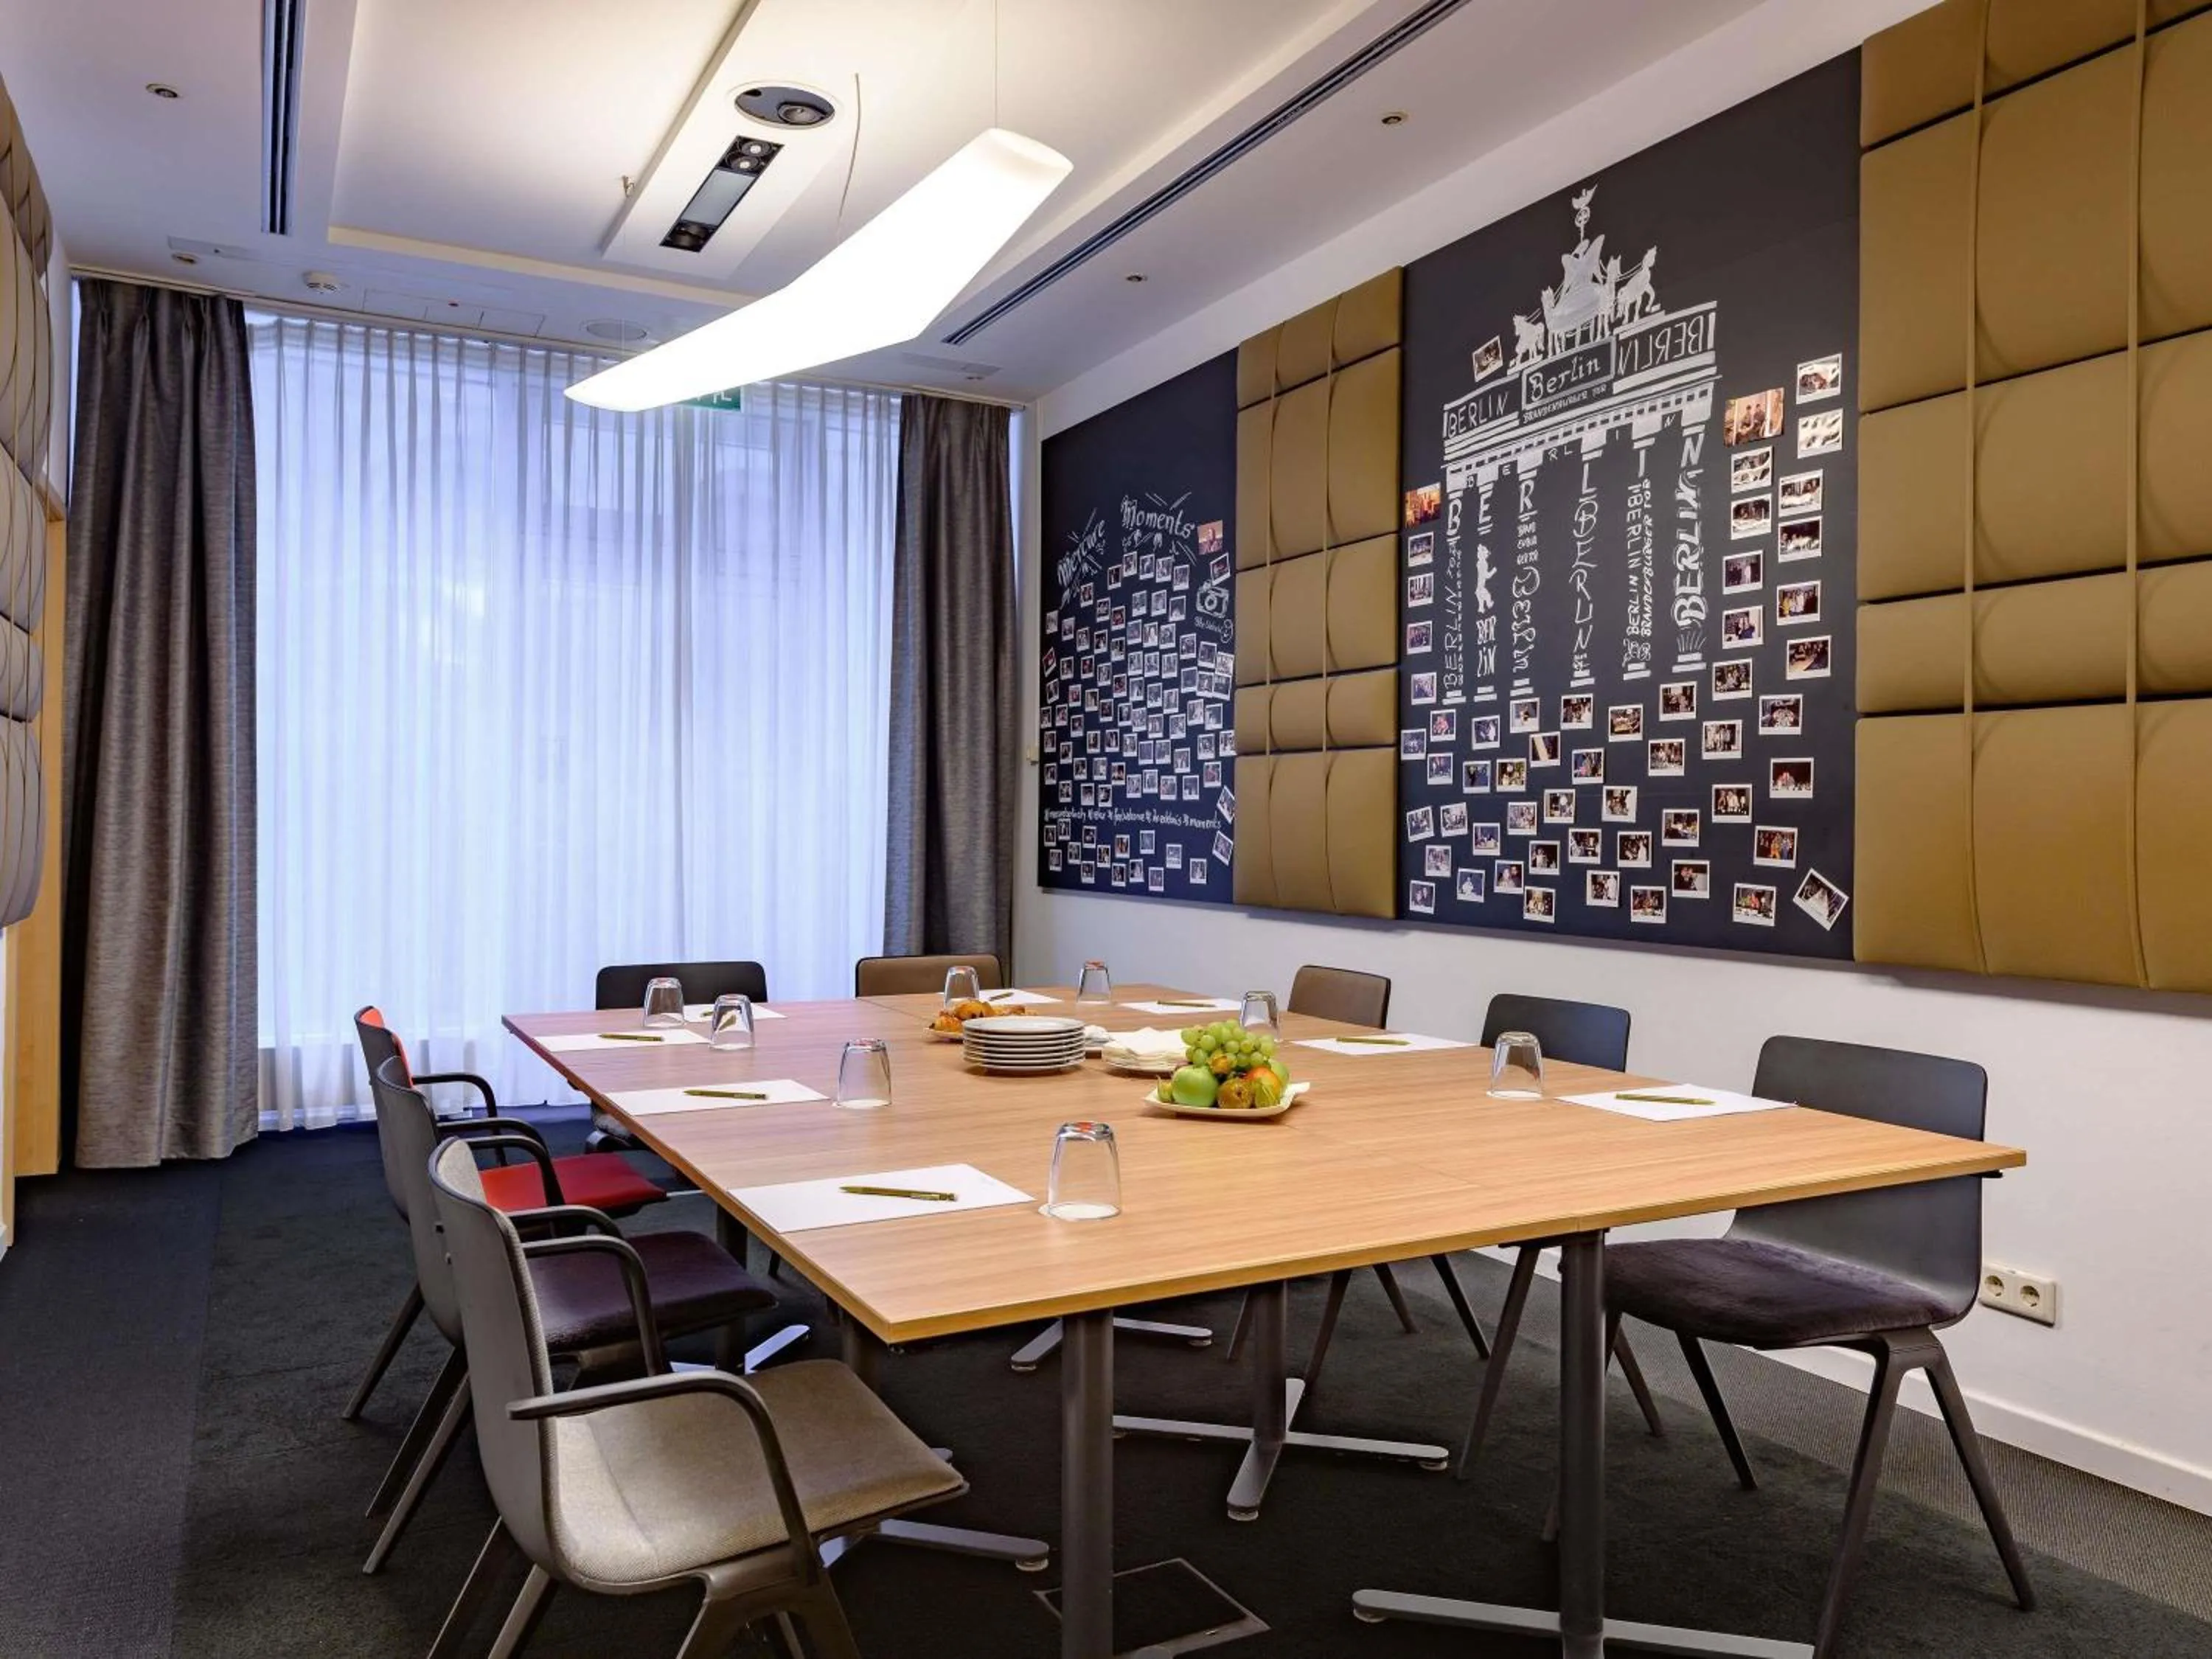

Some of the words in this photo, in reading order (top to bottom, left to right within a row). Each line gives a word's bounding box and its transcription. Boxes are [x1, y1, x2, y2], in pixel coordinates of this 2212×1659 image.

[1528, 355, 1601, 403] Berlin
[1448, 392, 1508, 438] BERLIN
[1626, 574, 1640, 636] BERLIN
[1444, 585, 1458, 689] BERLIN
